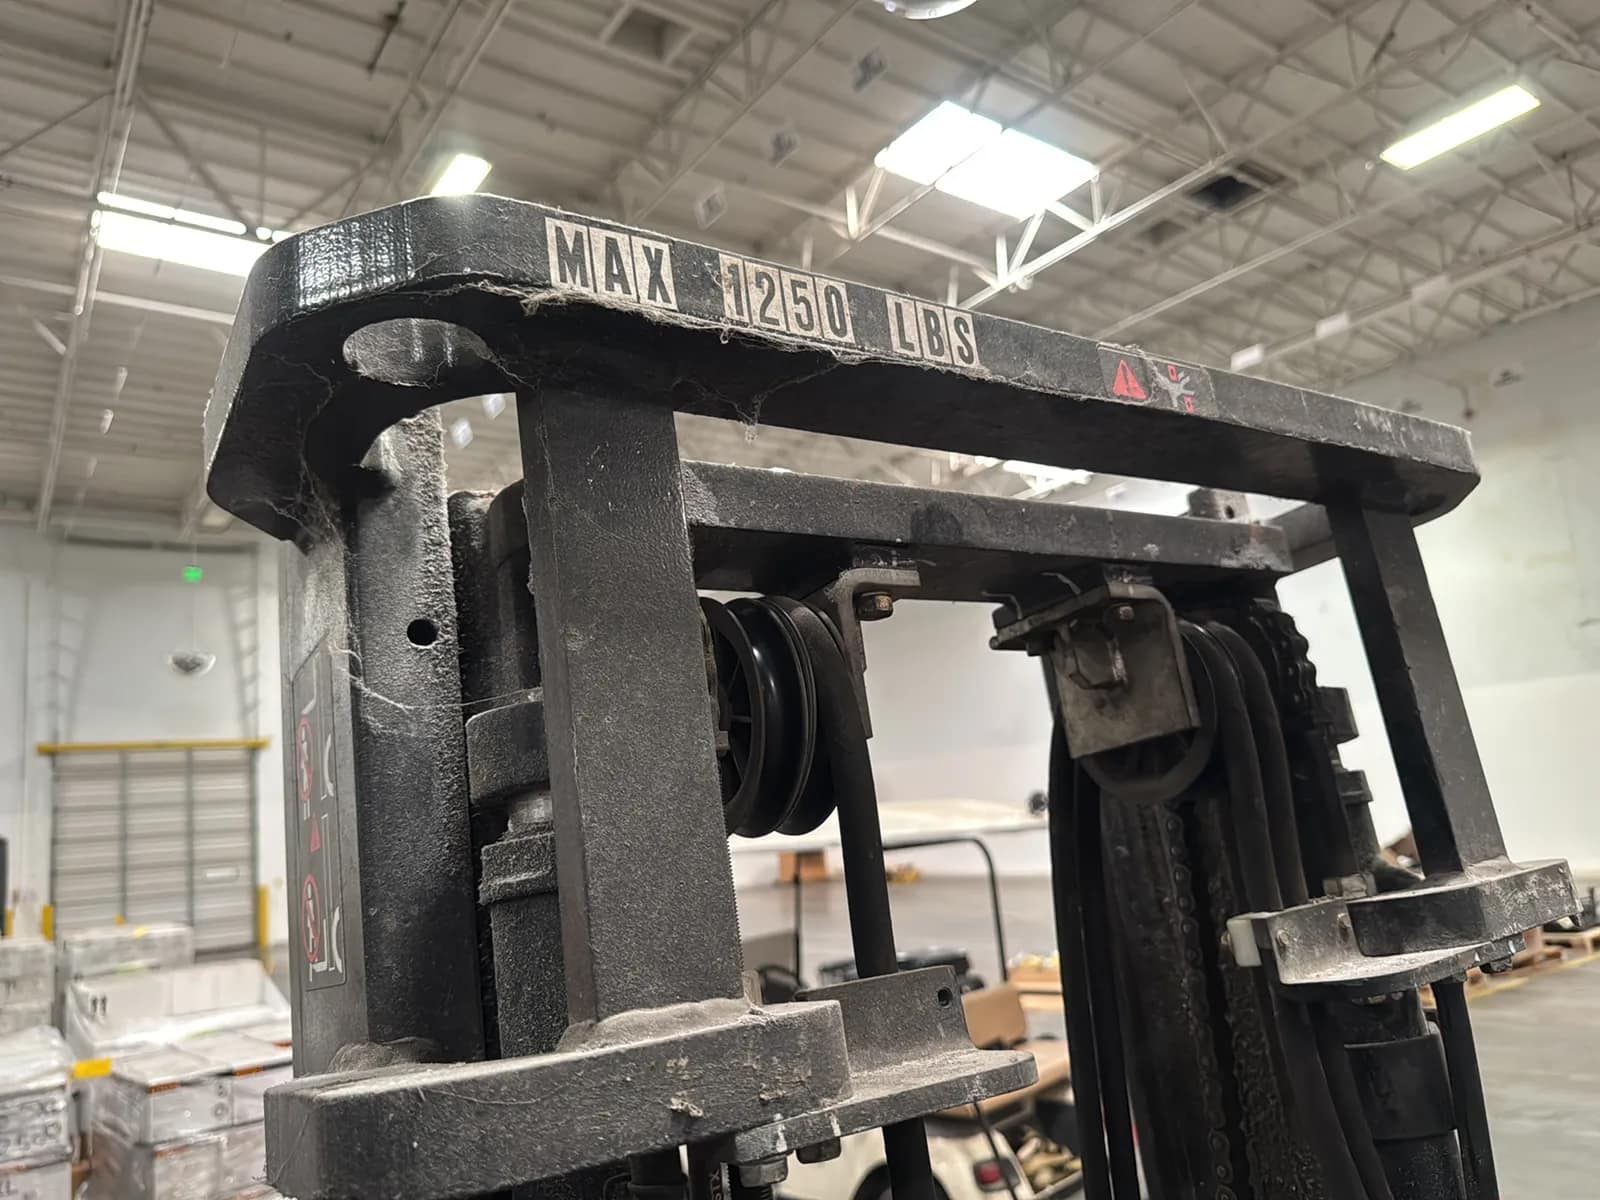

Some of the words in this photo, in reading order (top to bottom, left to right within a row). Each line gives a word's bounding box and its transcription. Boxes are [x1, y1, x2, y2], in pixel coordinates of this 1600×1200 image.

[554, 225, 672, 305] MAX
[726, 263, 848, 338] 1250
[893, 301, 975, 365] LBS
